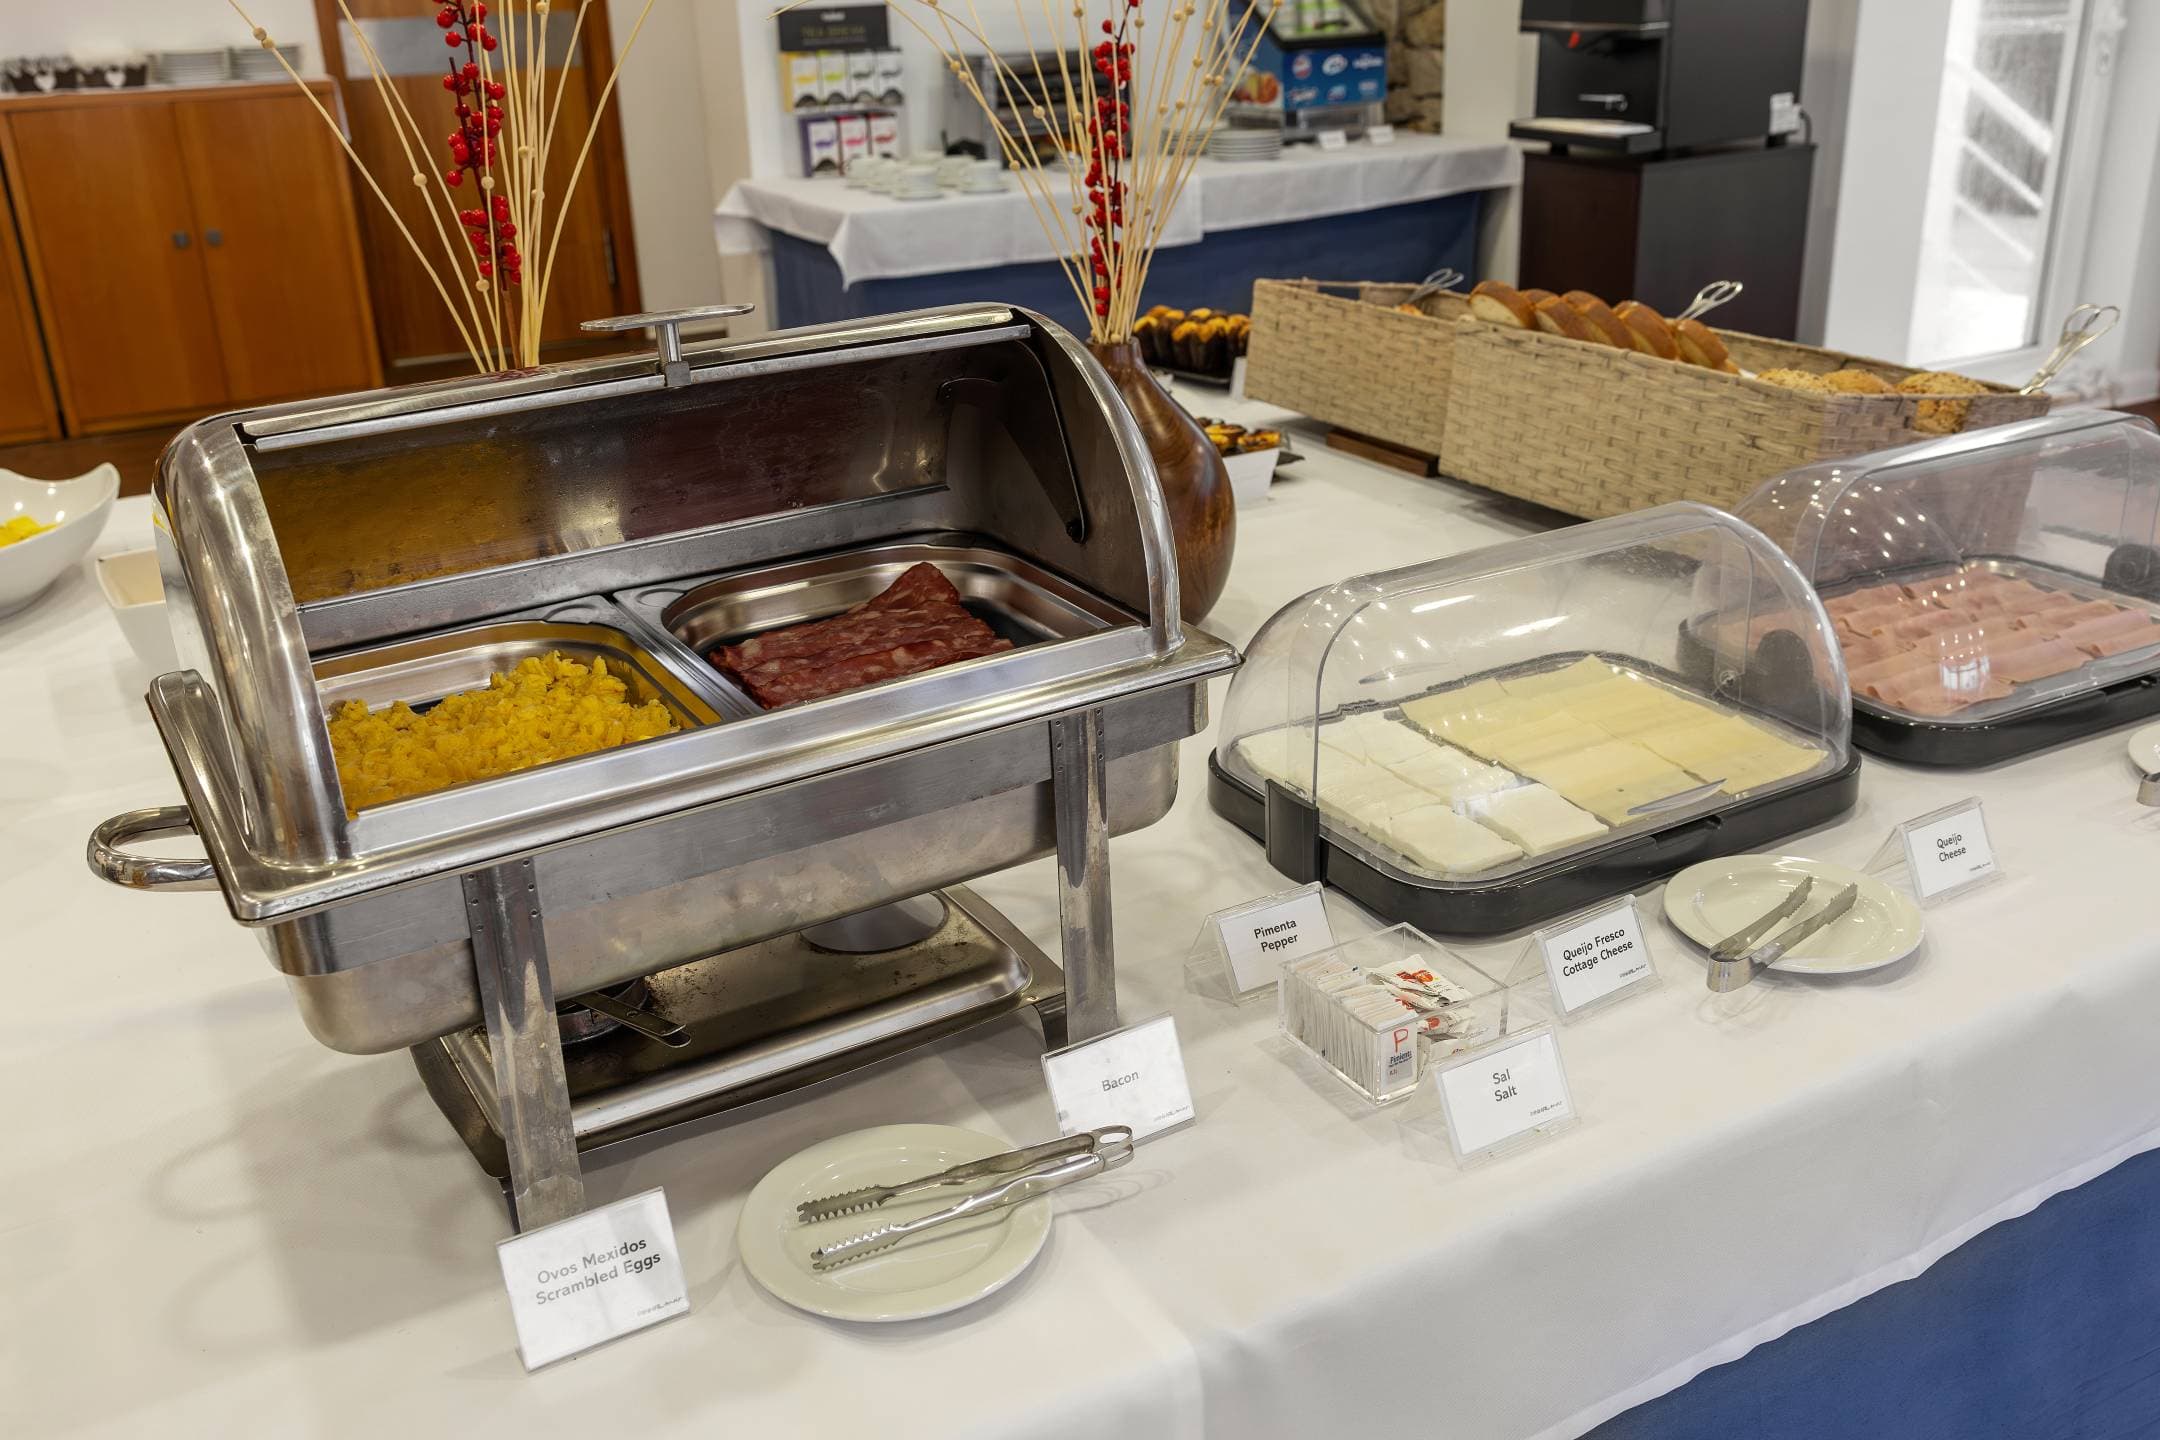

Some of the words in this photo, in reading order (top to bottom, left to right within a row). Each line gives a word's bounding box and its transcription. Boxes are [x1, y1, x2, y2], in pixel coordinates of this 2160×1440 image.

[1936, 832, 1963, 849] Queijo
[1938, 845, 1967, 862] Cheese
[1253, 918, 1298, 939] Pimenta
[1260, 933, 1299, 953] Pepper
[1562, 941, 1593, 961] Queijo
[1594, 928, 1625, 948] Fresco
[1562, 955, 1599, 977] Cottage
[1600, 940, 1634, 960] Cheese
[1101, 1070, 1140, 1092] Bacon
[1492, 1068, 1511, 1085] Sal
[1494, 1085, 1518, 1102] Salt
[537, 1263, 578, 1285] Ovos
[582, 1238, 647, 1270] Mexidos
[536, 1265, 619, 1305] Scrambled
[623, 1252, 662, 1275] Eggs
